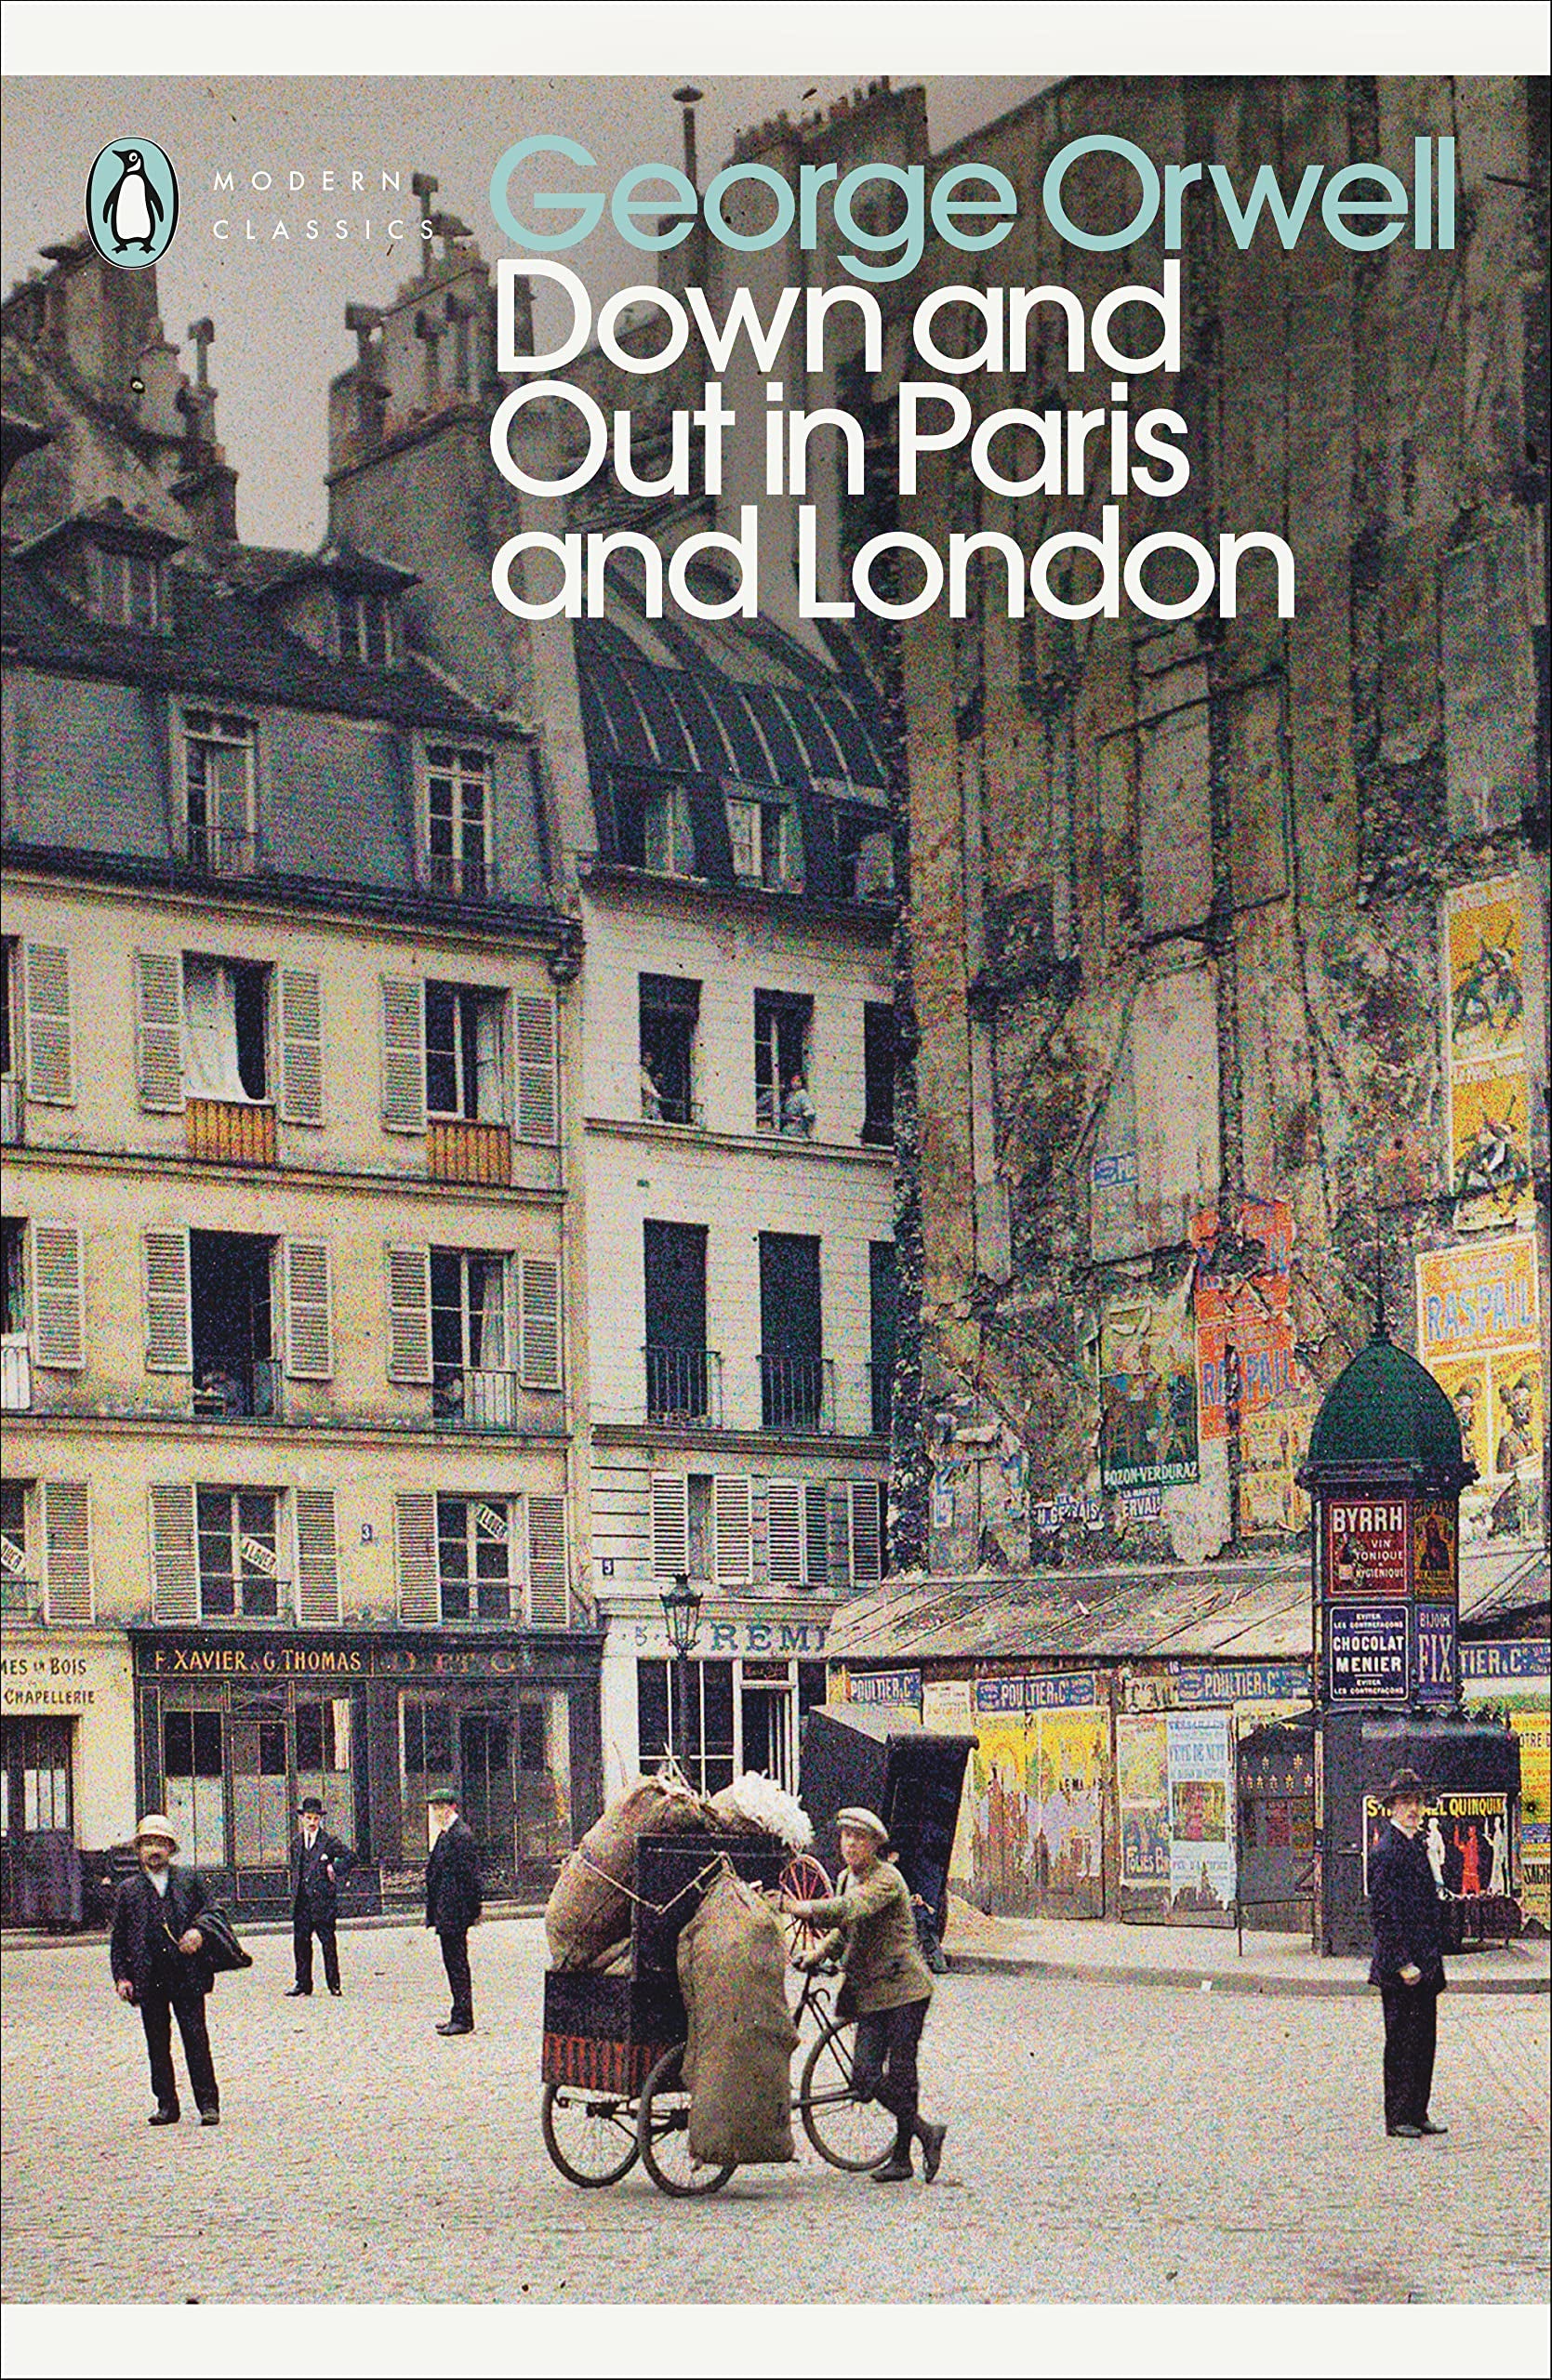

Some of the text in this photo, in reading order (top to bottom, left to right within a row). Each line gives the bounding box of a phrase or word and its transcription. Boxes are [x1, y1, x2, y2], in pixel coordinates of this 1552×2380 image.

[1426, 1277, 1532, 1341] RASPAIL
[1333, 1505, 1403, 1533] BYRRH
[1370, 1539, 1392, 1549] VIN
[1354, 1550, 1403, 1562] TONIQUE
[1333, 1635, 1405, 1651] CHOCOLAT
[49, 1657, 87, 1674] BOIS
[174, 1649, 248, 1672] XAVIER
[281, 1649, 362, 1672] THOMAS
[1335, 1657, 1402, 1673] MENIER
[1417, 1633, 1453, 1684] FIX
[1458, 1647, 1500, 1675] TIER
[4, 1687, 95, 1705] CHAPELLERIE
[1001, 1681, 1055, 1708] POULTIER
